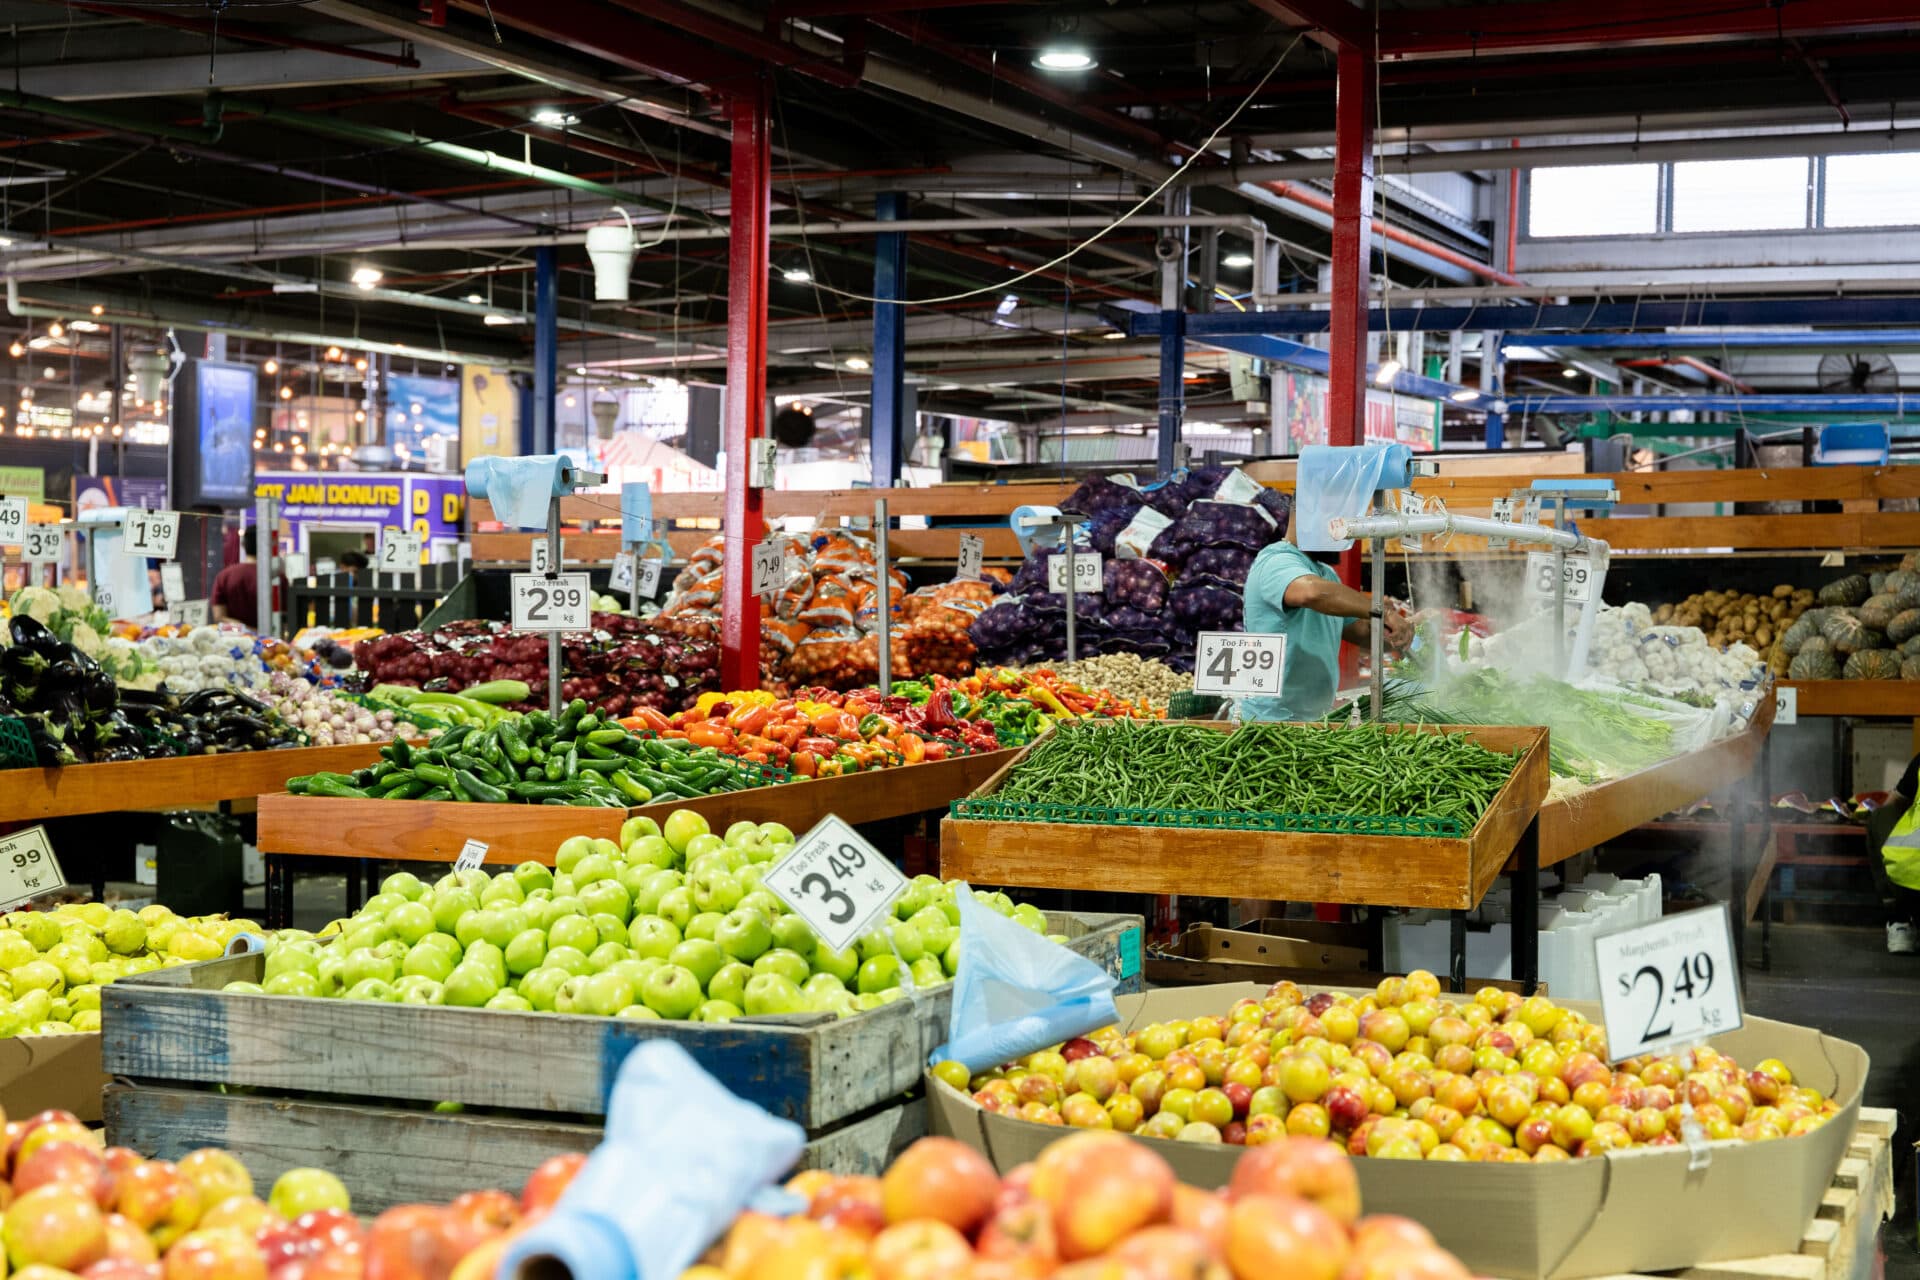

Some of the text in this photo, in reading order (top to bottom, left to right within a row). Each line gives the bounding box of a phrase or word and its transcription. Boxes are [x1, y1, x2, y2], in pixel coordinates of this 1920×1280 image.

[286, 484, 325, 505] JAM
[327, 484, 400, 506] DONUTS
[0, 510, 20, 525] 49
[548, 579, 569, 587] Fresh
[519, 587, 581, 621] $2.99
[563, 613, 575, 624] kg
[1221, 639, 1237, 648] Too
[1206, 646, 1275, 686] $4.99
[1252, 677, 1264, 688] kg
[0, 843, 17, 854] esh
[787, 840, 831, 877] Too Fresh
[24, 877, 41, 889] kg
[789, 842, 867, 926] $3.49
[865, 878, 886, 894] kg
[1618, 951, 1714, 1044] $2.49
[1701, 1007, 1721, 1028] kg
